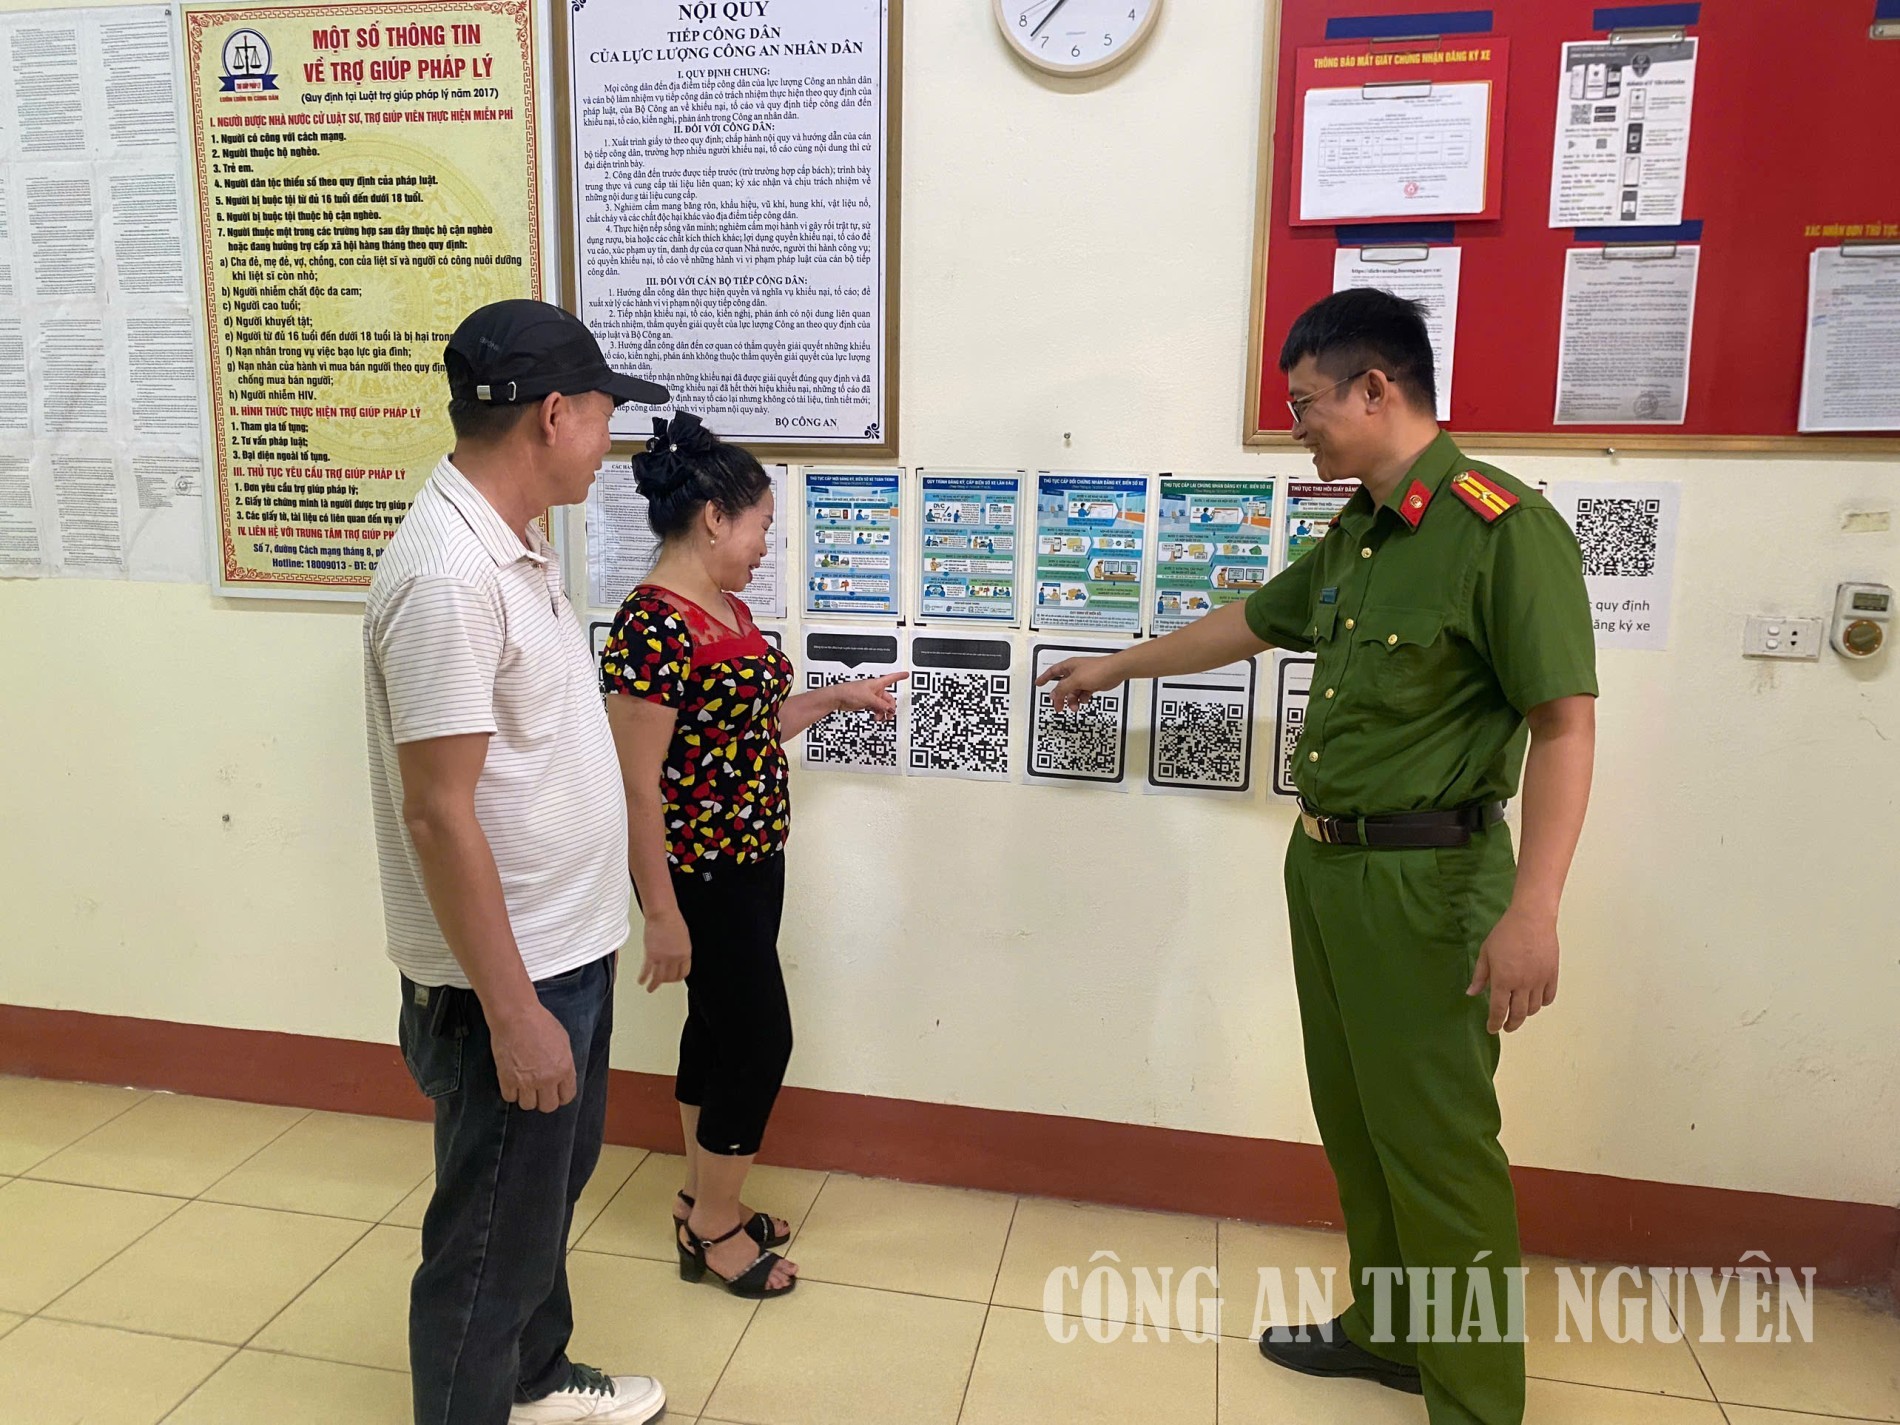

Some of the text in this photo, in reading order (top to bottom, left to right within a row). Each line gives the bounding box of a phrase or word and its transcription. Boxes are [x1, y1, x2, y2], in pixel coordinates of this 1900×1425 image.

[678, 0, 770, 24] NỘI QUY
[1128, 8, 1136, 21] 4
[1019, 15, 1028, 27] 8
[312, 20, 480, 53] MỘT SỐ THÔNG TIN
[667, 24, 780, 42] TIẾP CÔNG DÂN
[1040, 36, 1050, 48] 7
[1103, 34, 1113, 46] 5
[590, 39, 862, 64] CỦA LỰC LƯỢNG CÔNG AN NHÂN DÂN
[1071, 45, 1081, 57] 6
[1314, 50, 1490, 68] THÔNG BÁO MẤT GIẤY CHỨNG NHẬN ĐĂNG KÝ XE
[303, 53, 492, 85] VỀ TRỢ GIÚP PHÁP LÝ
[678, 67, 769, 80] I. QUY ĐỊNH CHUNG:
[301, 88, 498, 104] (Quy định tại Luật trợ giúp pháp lý năm 2017)
[210, 117, 215, 127] I.
[217, 114, 242, 127] NGƯỜI
[244, 115, 266, 128] ĐƯỢC
[268, 113, 286, 125] NHÀ
[288, 112, 310, 125] NƯỚC
[313, 111, 324, 124] CỬ
[326, 111, 346, 126] LUẬT
[364, 112, 380, 125] TRỢ
[382, 110, 402, 122] GIÚP
[404, 109, 424, 122] VIÊN
[426, 110, 448, 123] THỰC
[450, 108, 471, 123] HIỆN
[473, 106, 496, 120] MIỄN
[498, 107, 513, 120] PHÍ
[672, 121, 774, 133] II. ĐỐI VỚI CÔNG DÂN:
[646, 274, 808, 287] III. ĐỐI VỚI CÁN BỘ TIẾP CÔNG DÂN:
[230, 405, 420, 419] II. HÌNH THỨC THỰC HIỆN TRỢ GIÚP PHÁP LÝ
[775, 416, 836, 428] BỘ CÔNG AN
[233, 464, 405, 480] III. THỦ TỤC YÊU CẦU TRỢ GIÚP PHÁP LÝ
[238, 525, 396, 541] IV. LIÊN HỆ VỚI TRUNG TÂM TRỢ GIÚP PH
[272, 558, 304, 568] Hotline:
[306, 560, 346, 569] 18009013
[354, 561, 366, 570] ĐT:
[1595, 599, 1650, 612] quy định
[1593, 619, 1651, 632] ăng ký xe
